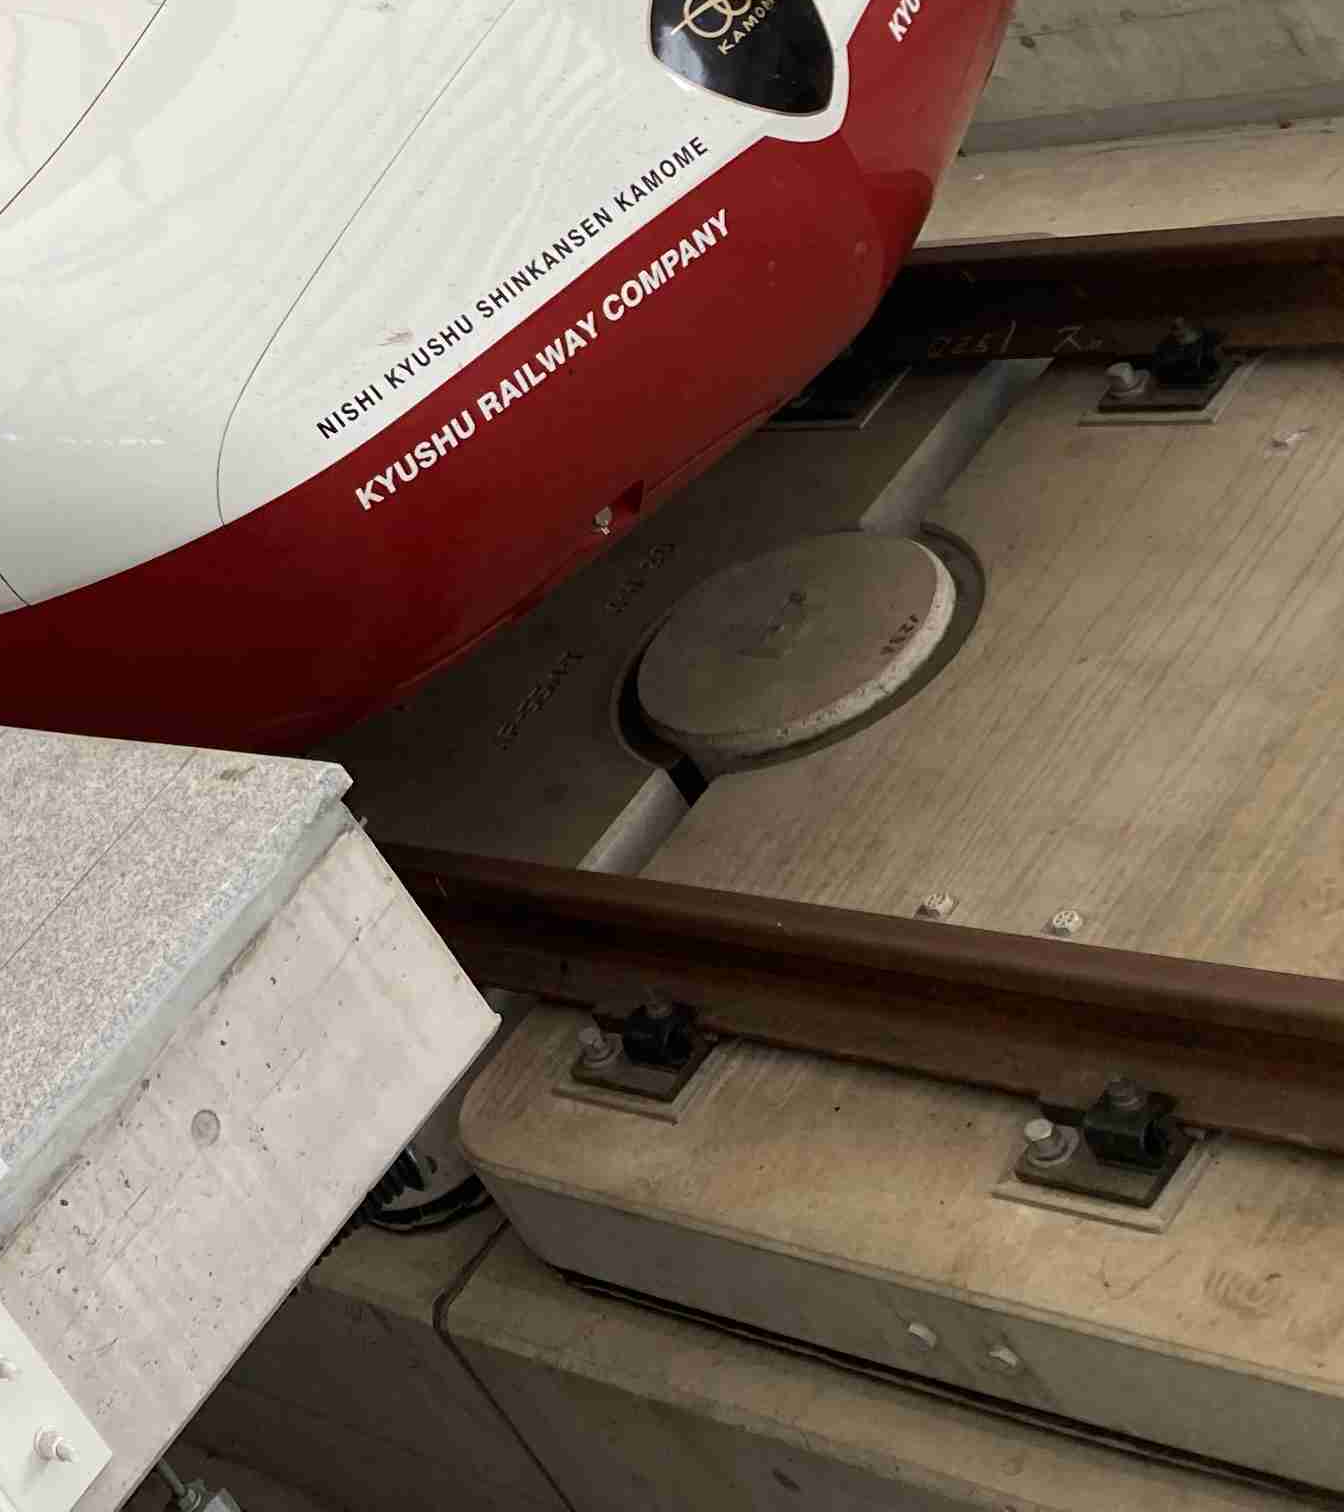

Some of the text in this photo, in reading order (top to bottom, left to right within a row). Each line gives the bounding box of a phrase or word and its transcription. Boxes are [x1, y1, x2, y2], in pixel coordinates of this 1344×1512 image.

[316, 136, 709, 439] NISHI KYUSHU SHINKANSEN KAMOME
[355, 208, 730, 511] KYUSHU RAILWAY COMPANY
